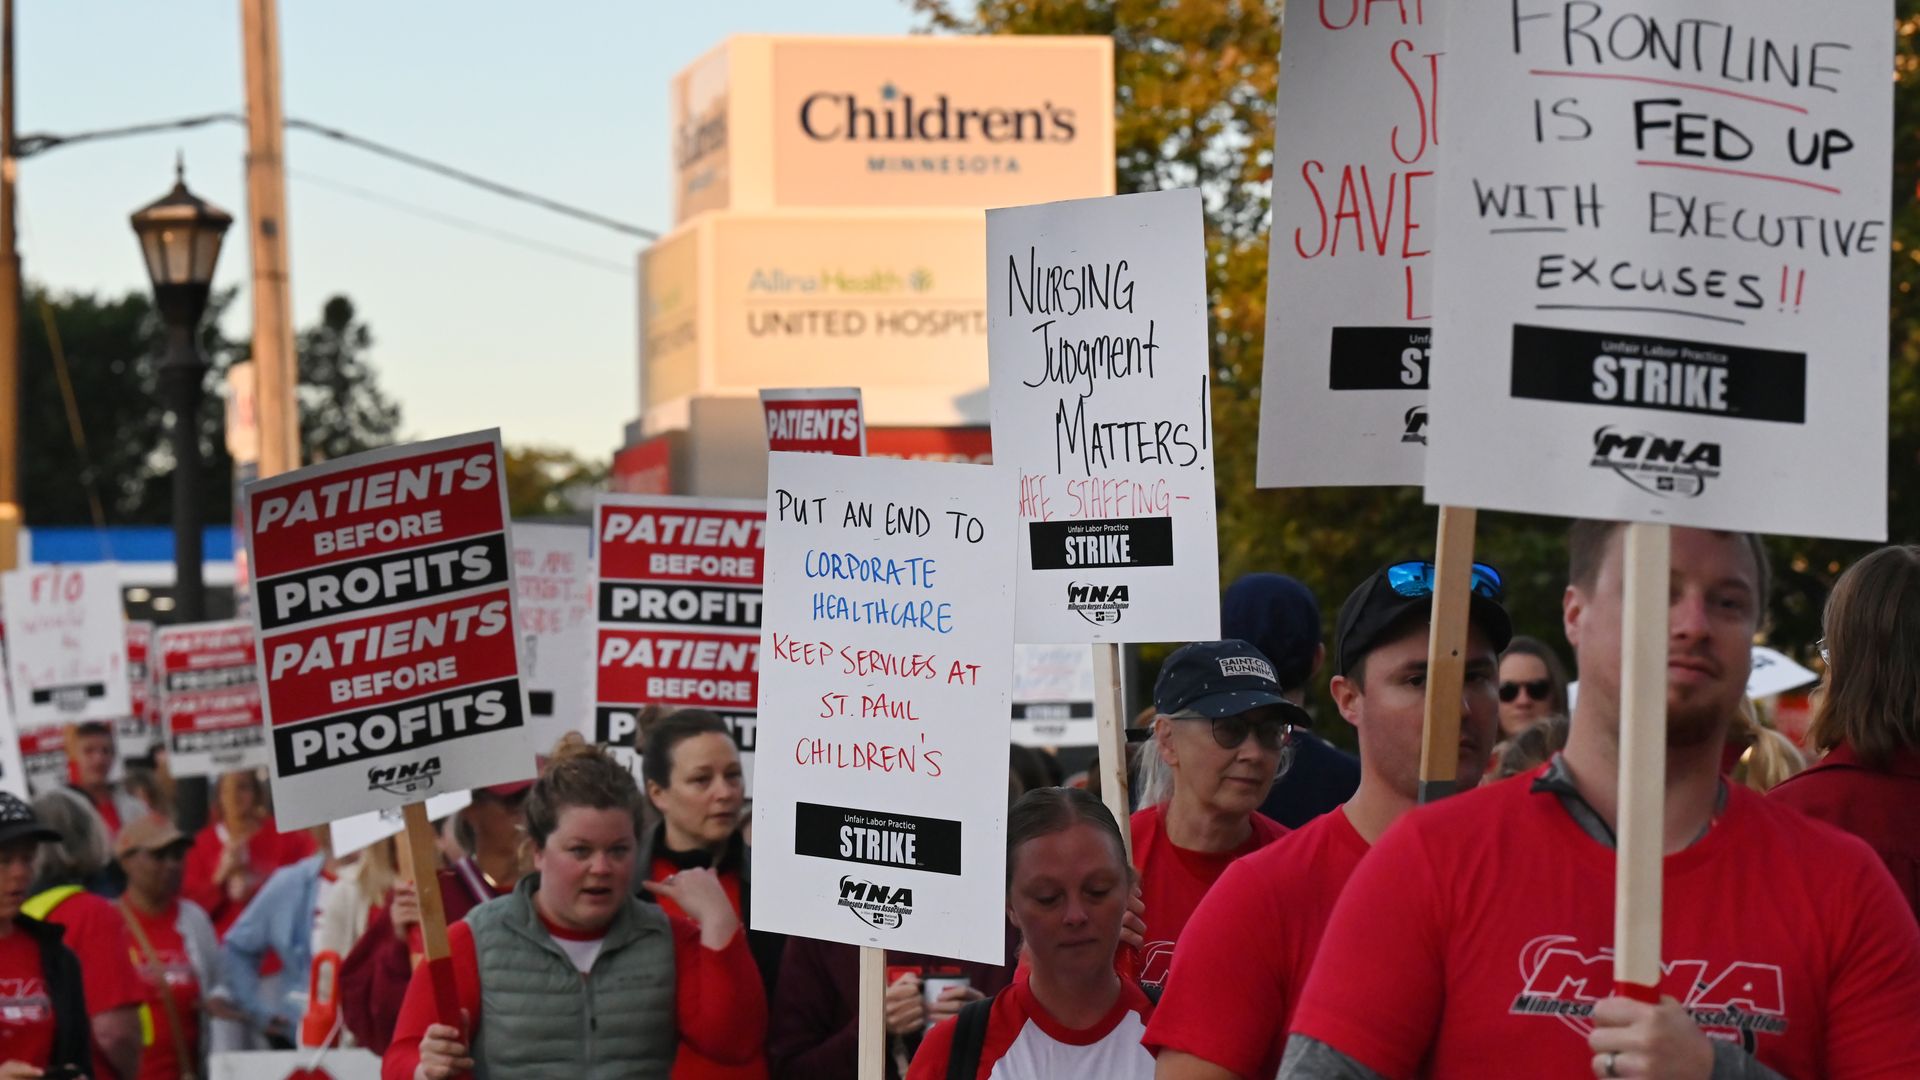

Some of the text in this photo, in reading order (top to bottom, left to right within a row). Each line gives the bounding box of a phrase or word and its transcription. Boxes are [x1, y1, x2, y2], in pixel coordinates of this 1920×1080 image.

[1512, 0, 1853, 93] FRONTLINE
[799, 83, 1079, 145] Children's
[1391, 39, 1446, 163] ST
[1535, 97, 1855, 170] IS FED UP
[867, 156, 1021, 174] MINNESOTA
[1294, 160, 1435, 259] SAVE
[1473, 178, 1885, 257] WITH EXECUTIVE
[1009, 246, 1135, 317] NURSING
[1537, 255, 1806, 314] EXCUSES!!
[747, 309, 867, 338] UNITED
[1602, 340, 1728, 363] Unfair Labor Practice
[1592, 355, 1728, 411] STRIKE
[768, 409, 858, 440] PATIENTS
[1056, 375, 1206, 476] MATTERS!
[1595, 434, 1720, 467] MNA
[256, 454, 493, 534] PATIENTS
[1019, 475, 1054, 522] AFE
[314, 510, 443, 556] BEFORE
[603, 514, 766, 548] PATIENT
[776, 490, 984, 544] PUT AN END TO
[649, 554, 754, 577] BEFORE
[805, 549, 936, 588] CORPORATE
[1065, 534, 1131, 565] STRIKE
[274, 545, 492, 620] PROFITS
[1069, 585, 1129, 602] MNA
[612, 588, 763, 623] PROFIT
[813, 592, 953, 633] HEALTHCARE
[270, 600, 508, 681] PATIENTS
[601, 637, 759, 672] PATIENT
[773, 632, 833, 666] KEEP
[843, 646, 936, 679] SERVICES
[948, 661, 981, 686] AT
[330, 656, 457, 704] BEFORE
[646, 677, 752, 700] BEFORE
[820, 692, 920, 720] ST. PAUL
[291, 690, 507, 768] PROFITS
[370, 757, 441, 783] MNA
[796, 733, 942, 777] CHILDREN'S
[844, 814, 916, 830] Unfair Labor Practice
[840, 825, 916, 865] STRIKE
[840, 881, 912, 907] MNA
[1512, 995, 1597, 1017] Minneso
